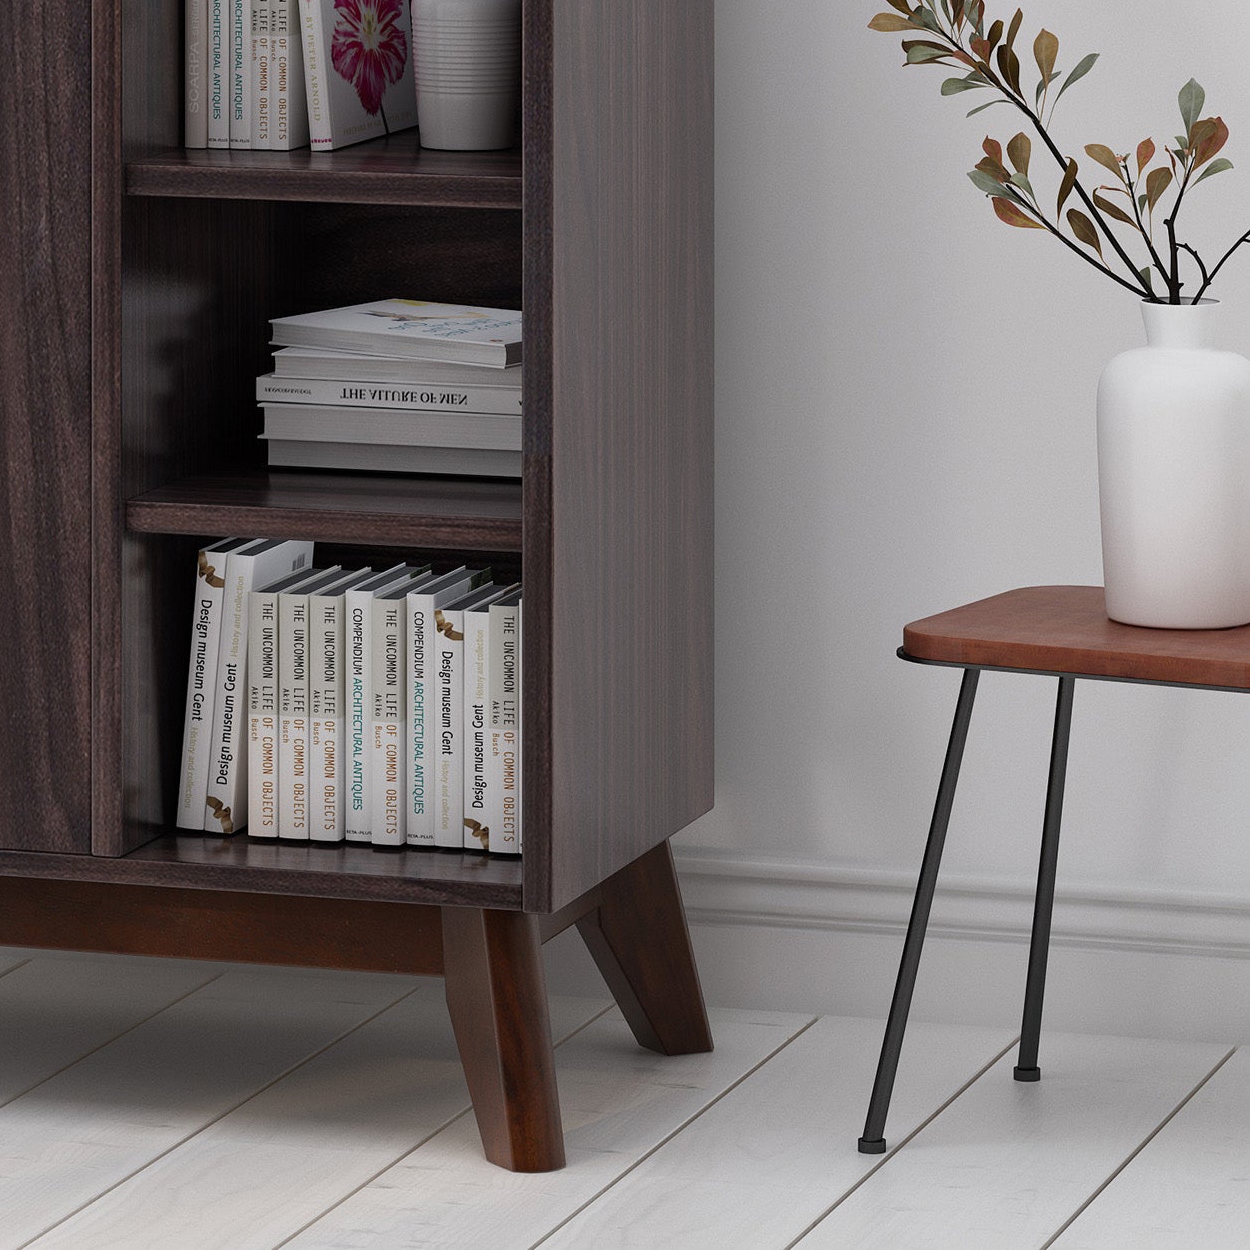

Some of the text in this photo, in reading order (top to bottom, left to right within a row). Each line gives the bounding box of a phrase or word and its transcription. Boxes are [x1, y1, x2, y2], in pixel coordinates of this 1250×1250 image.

[260, 9, 268, 31] LIFE
[278, 10, 286, 32] LIFE
[306, 16, 313, 29] BY
[260, 38, 268, 50] OF
[278, 38, 286, 50] OF
[308, 35, 316, 70] PETER
[188, 41, 200, 113] SCARPA
[260, 56, 268, 91] COMMON
[278, 56, 286, 92] COMMON
[212, 72, 221, 120] ANTIQUES
[234, 73, 243, 120] ANTIQUES
[311, 75, 321, 121] ARNOLD
[260, 98, 268, 140] OBJECTS
[278, 98, 286, 140] OBJECTS
[235, 576, 244, 612] collection
[196, 600, 212, 638] Design
[230, 631, 240, 657] History
[194, 641, 206, 689] museum
[224, 663, 237, 690] Gent
[439, 651, 453, 684] Design
[192, 693, 204, 721] Gent
[222, 696, 234, 742] museum
[262, 603, 273, 826] THE UNCOMMON LIFE OF COMMON OBJECTS
[294, 604, 304, 828] THE UNCOMMON LIFE OF COMMON OBJECTS
[324, 606, 335, 830] THE UNCOMMON LIFE OF COMMON OBJECTS
[351, 608, 362, 810] COMPENDIUM ARCHITECTURAL ANTIQUES
[386, 609, 397, 834] THE UNCOMMON LIFE OF COMMON OBJECTS
[412, 611, 424, 814] COMPENDIUM ARCHITECTURAL ANTIQUES
[442, 687, 450, 728] museum
[472, 704, 483, 728] Gent
[442, 731, 453, 755] Gent
[492, 701, 500, 756] Akiko Busch
[504, 616, 515, 842] THE UNCOMMON LIFE OF COMMON OBJECTS
[216, 744, 232, 785] Design
[441, 760, 449, 782] History
[475, 732, 483, 772] museum
[472, 776, 487, 809] Design
